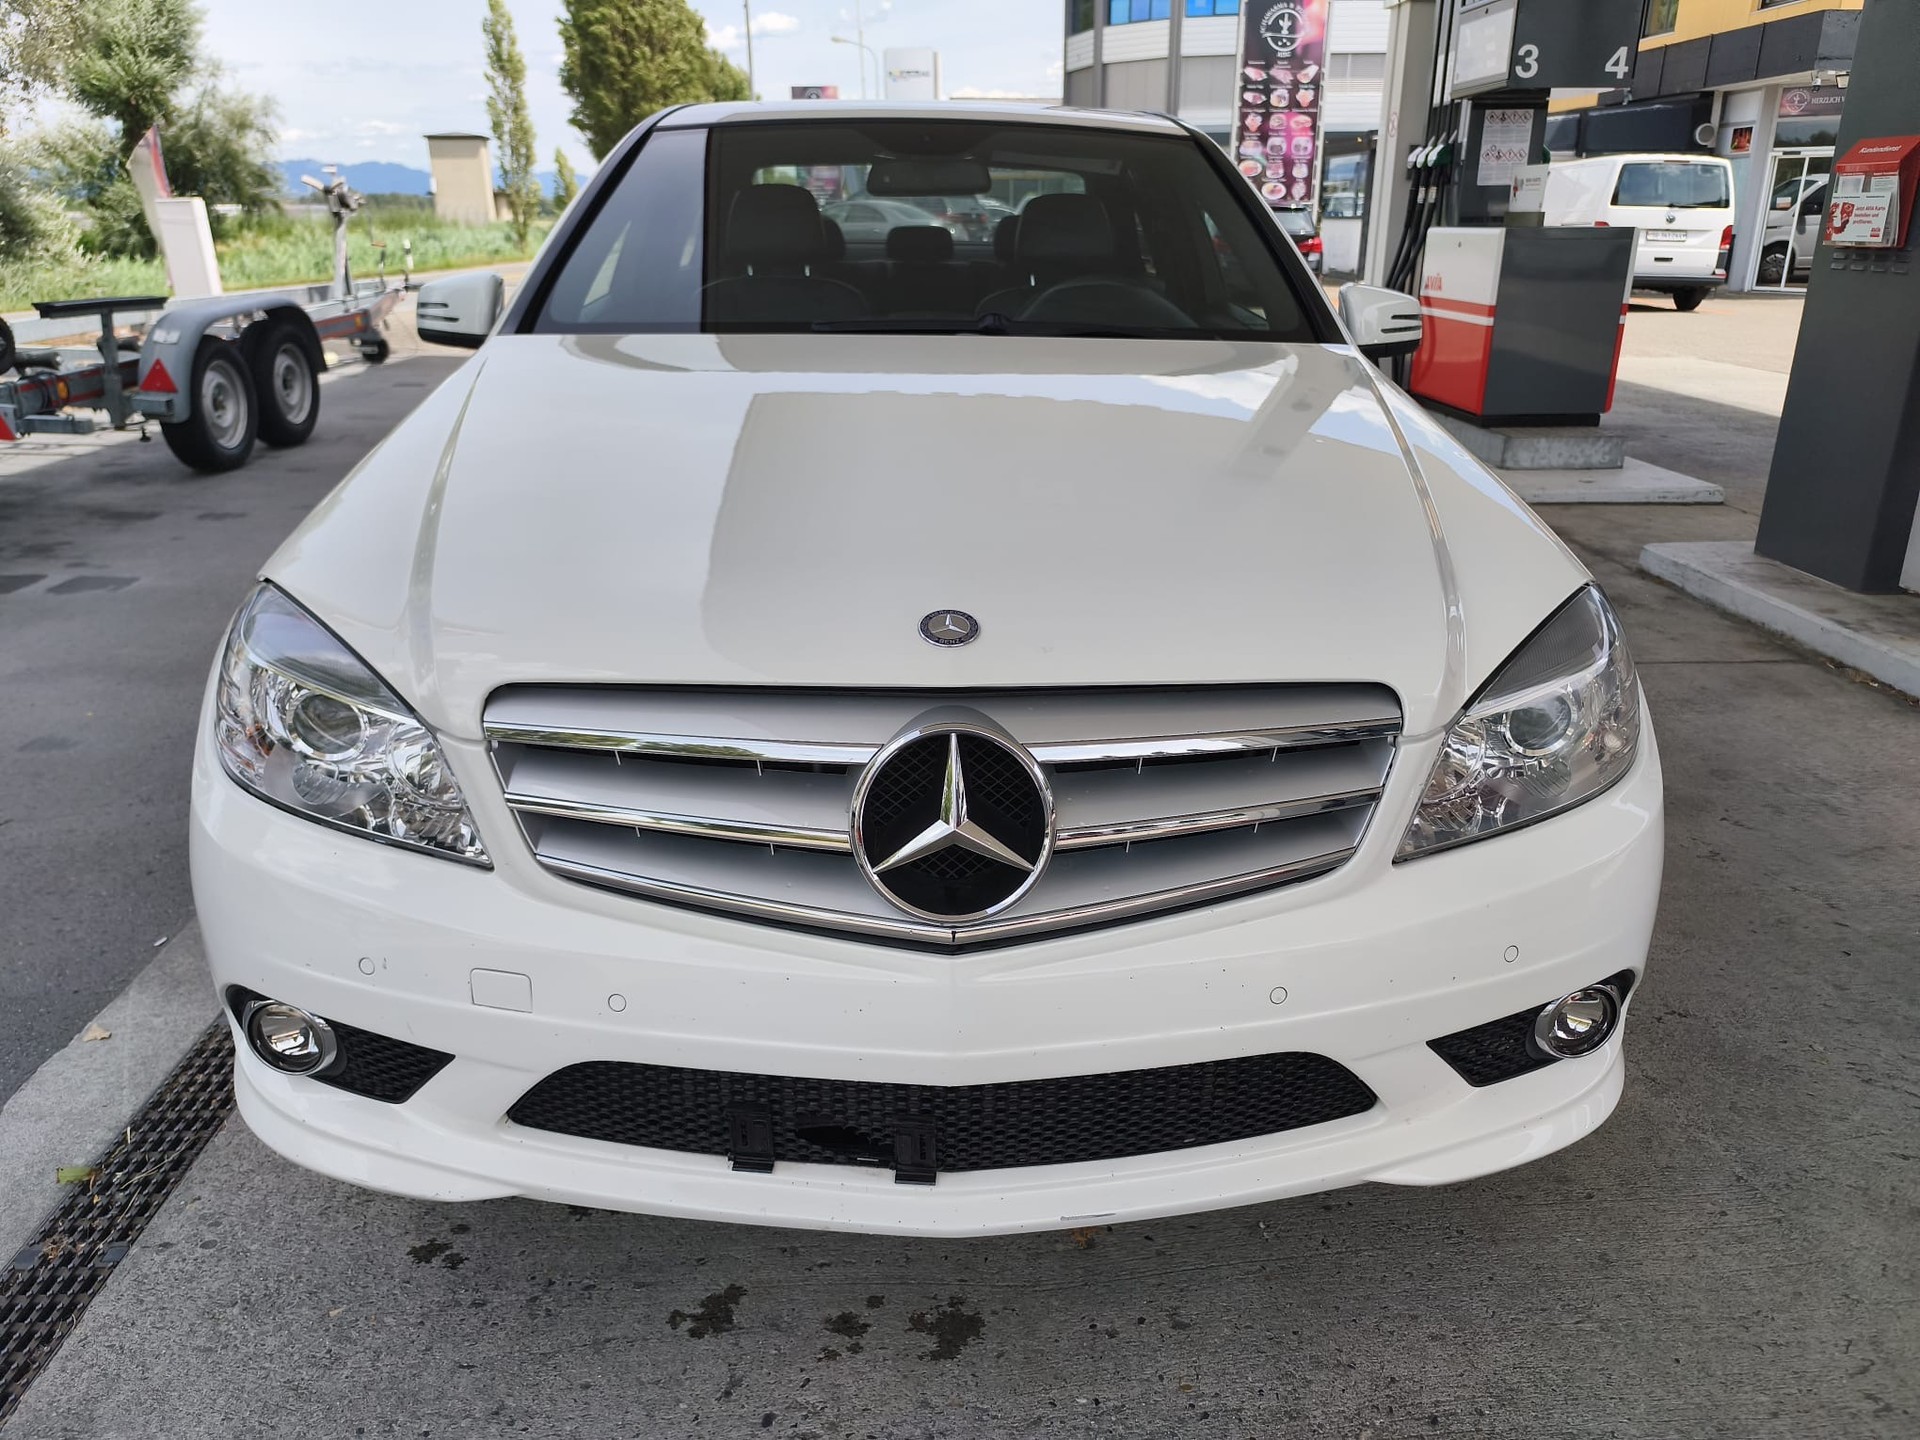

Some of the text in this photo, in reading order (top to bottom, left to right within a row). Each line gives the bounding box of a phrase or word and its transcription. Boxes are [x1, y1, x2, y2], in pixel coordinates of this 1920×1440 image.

[1515, 44, 1539, 79] 3
[1604, 46, 1629, 79] 4
[1424, 275, 1442, 291] AVIA
